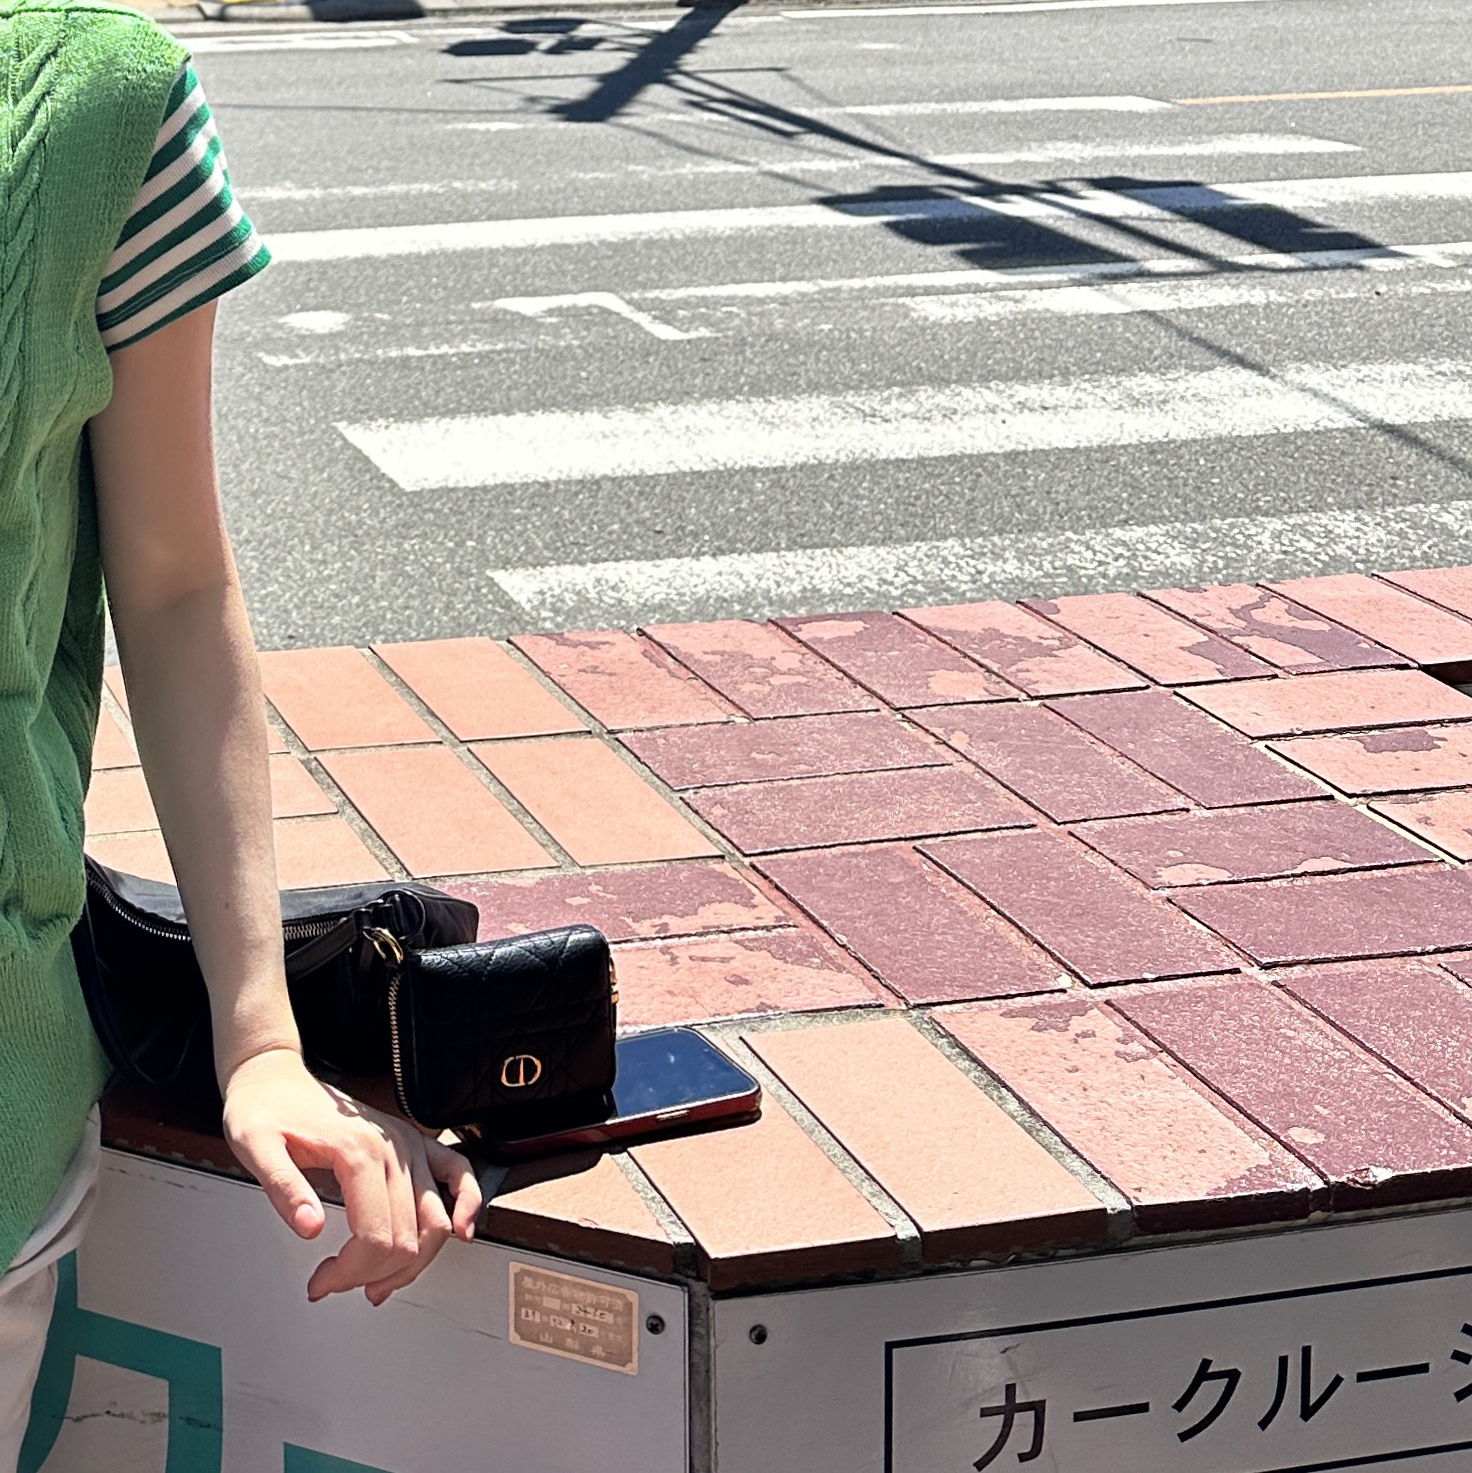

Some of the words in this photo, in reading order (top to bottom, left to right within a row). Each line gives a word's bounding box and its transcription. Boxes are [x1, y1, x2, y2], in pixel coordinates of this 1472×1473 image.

[972, 1322, 1472, 1472] カークルー
